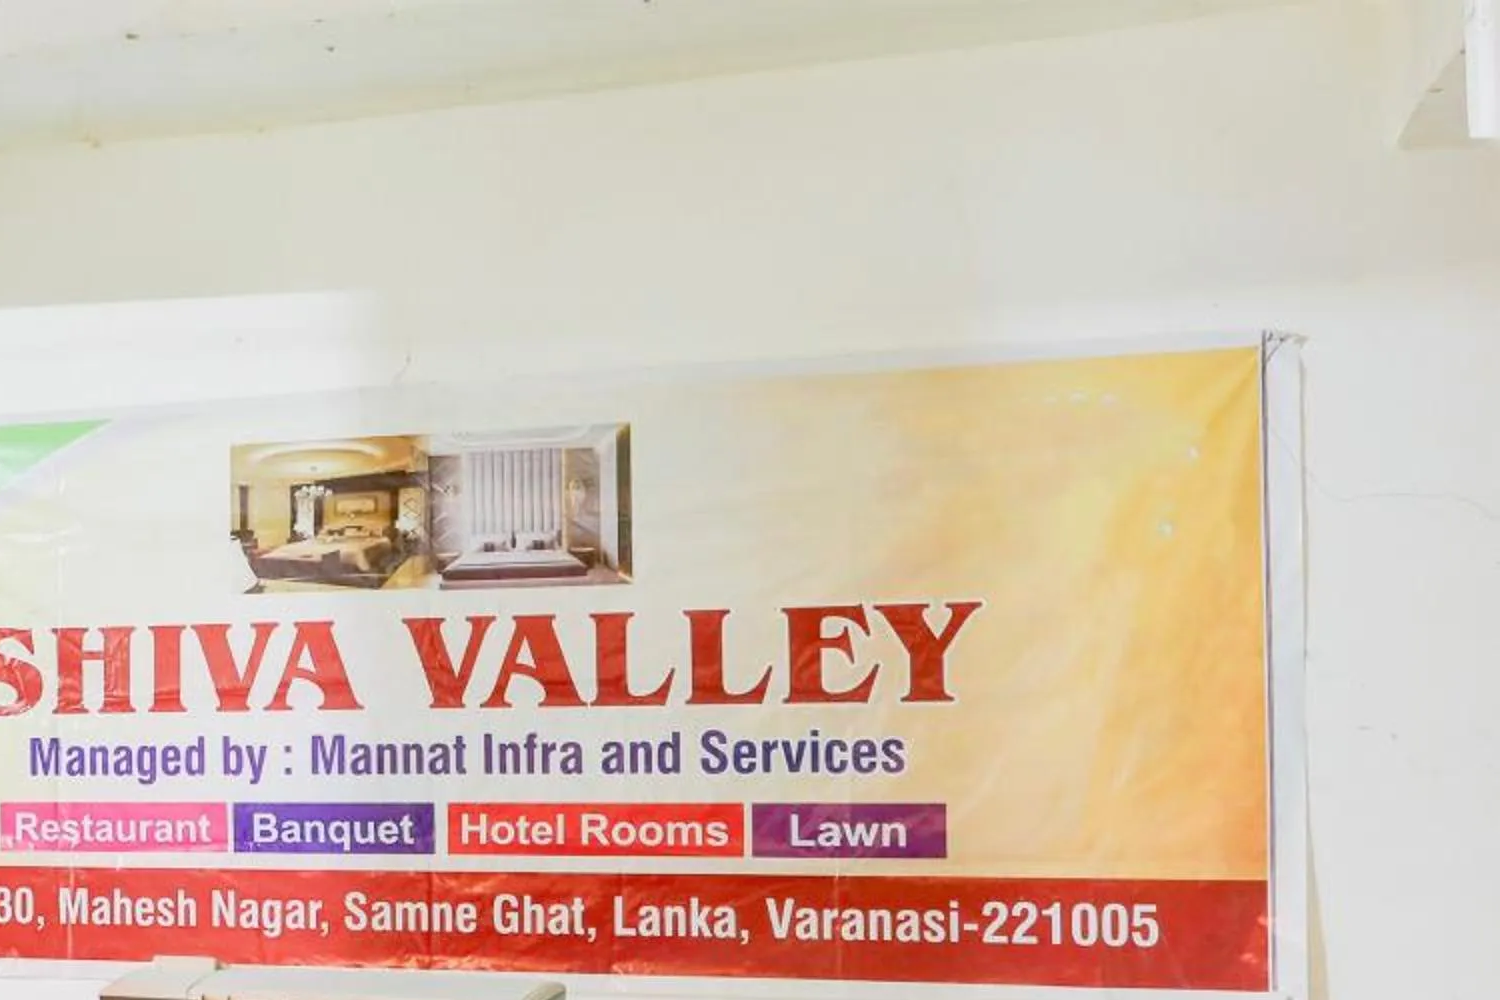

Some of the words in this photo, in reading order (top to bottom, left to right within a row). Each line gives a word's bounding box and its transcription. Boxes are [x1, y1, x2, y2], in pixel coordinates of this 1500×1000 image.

[402, 601, 983, 708] VALLEY
[29, 736, 205, 784] Managed
[223, 736, 267, 784] by
[311, 735, 466, 775] Mannat
[484, 733, 583, 774] Infra
[601, 732, 681, 774] and
[700, 729, 906, 774] Services
[15, 812, 211, 844] Restaurant
[252, 814, 414, 850] Banquet
[461, 813, 564, 845] Hotel
[581, 813, 729, 846] Rooms
[790, 814, 906, 847] Lawn
[59, 887, 197, 927] Mahesh
[211, 889, 330, 940] Nagar,
[344, 892, 476, 933] Samne
[493, 893, 597, 942] Ghat,
[614, 896, 749, 945] Lanka,
[765, 897, 1159, 948] Varanasi-221005
